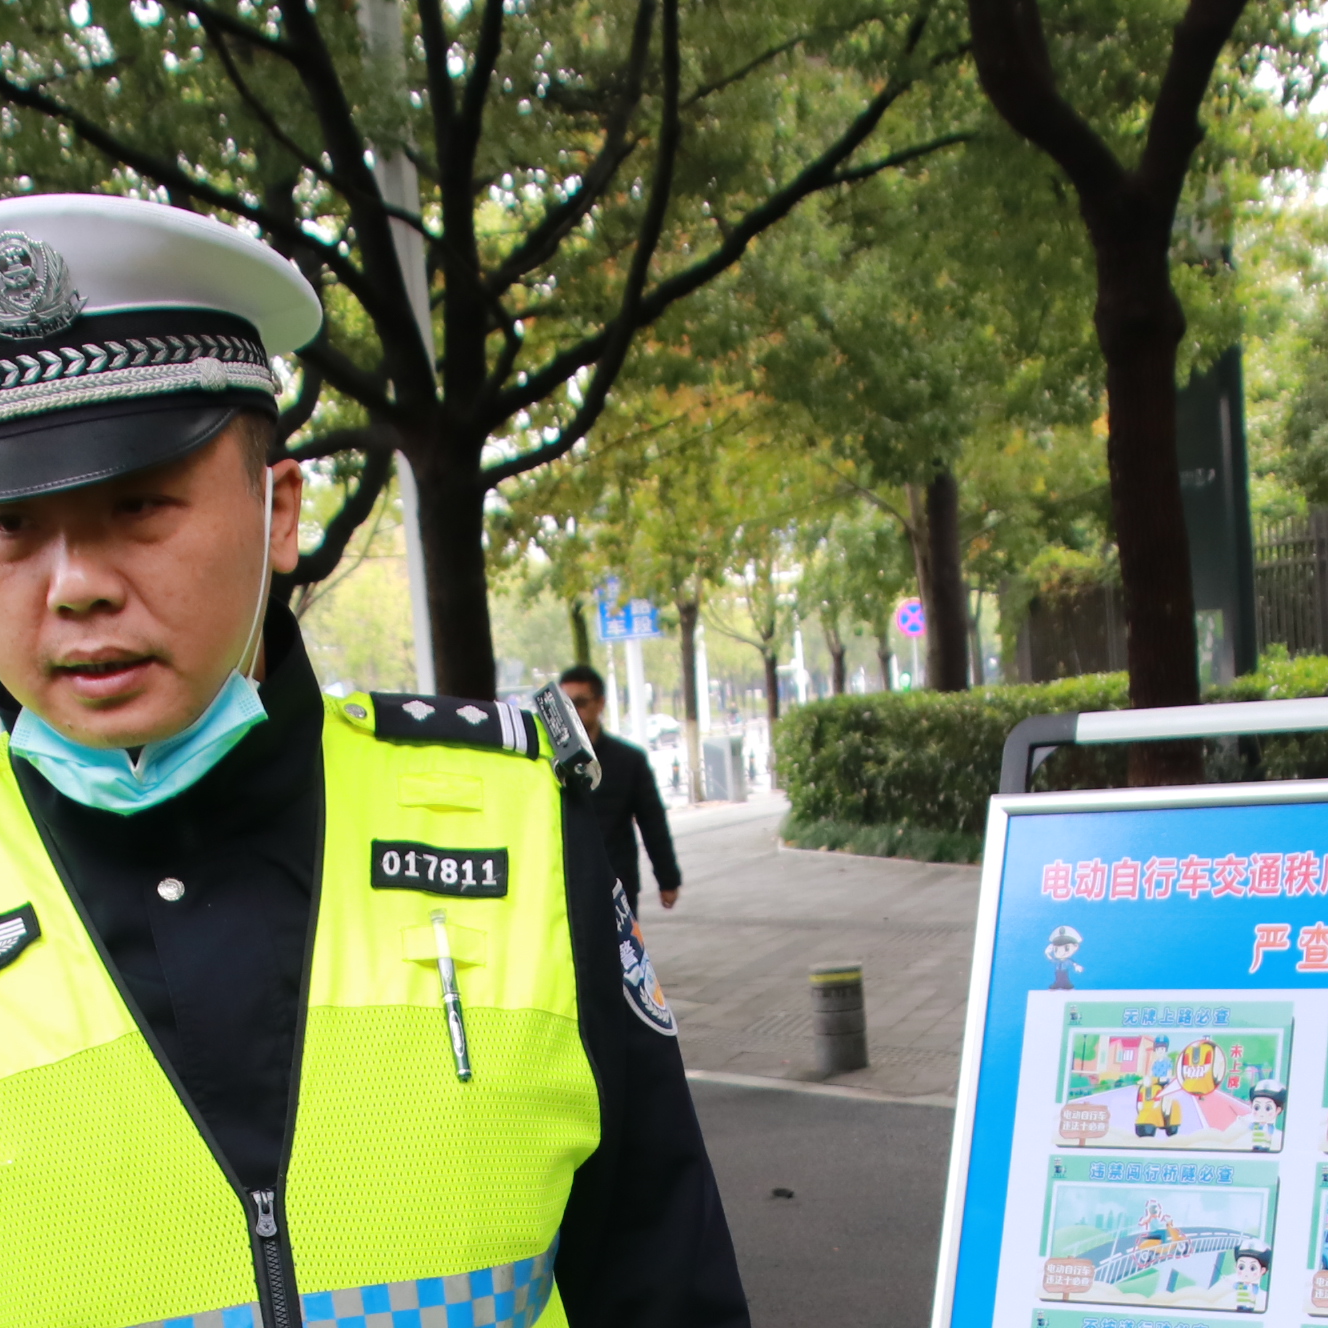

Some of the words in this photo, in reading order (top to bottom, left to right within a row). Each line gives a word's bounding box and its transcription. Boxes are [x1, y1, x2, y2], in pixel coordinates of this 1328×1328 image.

[381, 850, 497, 885] 017811
[1123, 1006, 1230, 1026] 无牌上路必查
[1063, 1110, 1107, 1121] 电动自行车
[1089, 1161, 1235, 1184] 违禁闯行桥隧必查
[1047, 1264, 1090, 1276] 电动自行车
